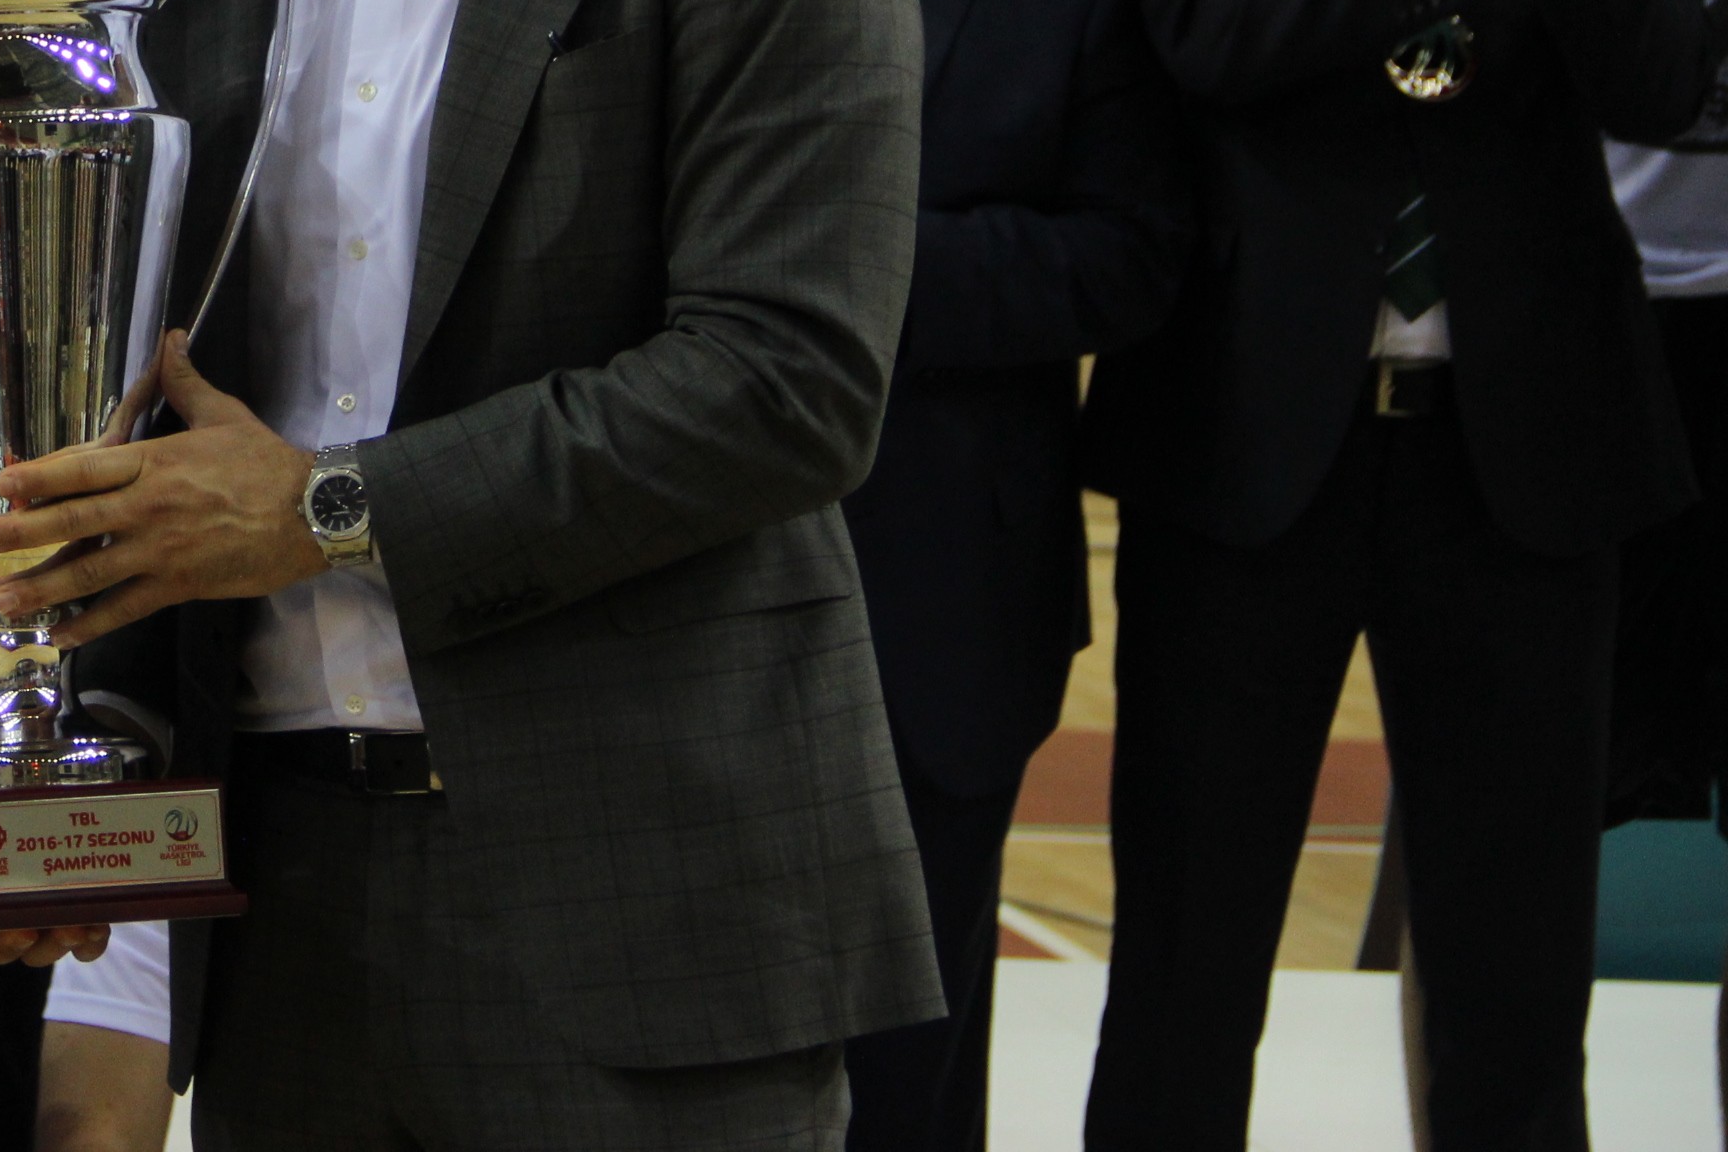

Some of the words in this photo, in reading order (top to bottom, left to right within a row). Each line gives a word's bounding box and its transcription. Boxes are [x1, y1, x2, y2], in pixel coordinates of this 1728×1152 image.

[68, 812, 100, 827] TBL
[16, 834, 83, 852] 2016-17
[87, 830, 155, 847] SEZONU
[42, 852, 132, 875] ŞAMPİYON
